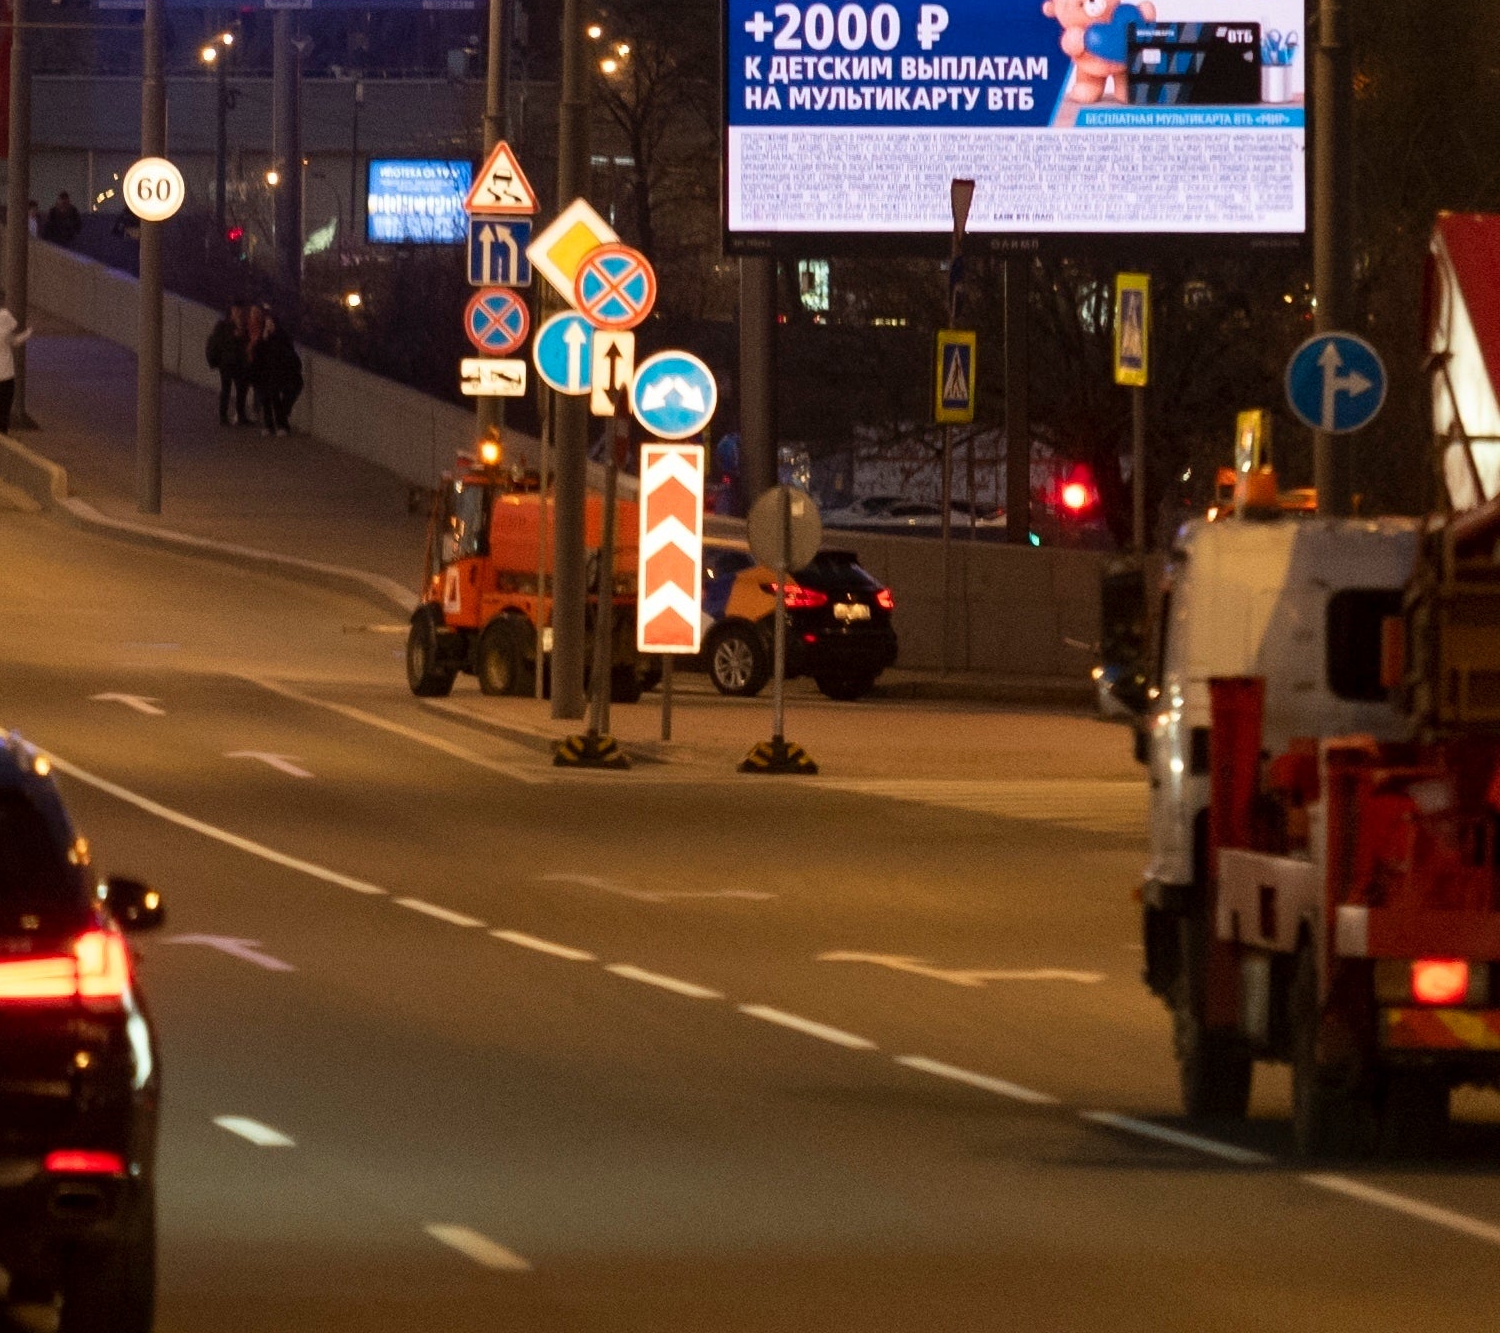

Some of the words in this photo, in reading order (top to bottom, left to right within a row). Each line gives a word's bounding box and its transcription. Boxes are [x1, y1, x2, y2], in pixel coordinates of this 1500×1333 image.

[743, 3, 901, 51] +2000
[1227, 28, 1254, 44] ВТБ
[744, 56, 762, 81] К
[768, 56, 893, 84] ДЕТСКИМ
[901, 56, 1049, 81] ВЫПЛАТАМ
[744, 86, 782, 111] НА
[789, 86, 980, 112] МУЛЬТИКАРТУ
[987, 87, 1035, 111] ВТБ
[1085, 112, 1154, 125] БЕСПЛАТНАЯ
[1155, 112, 1232, 125] МУЛЬТИКАРТА
[137, 177, 171, 202] 60
